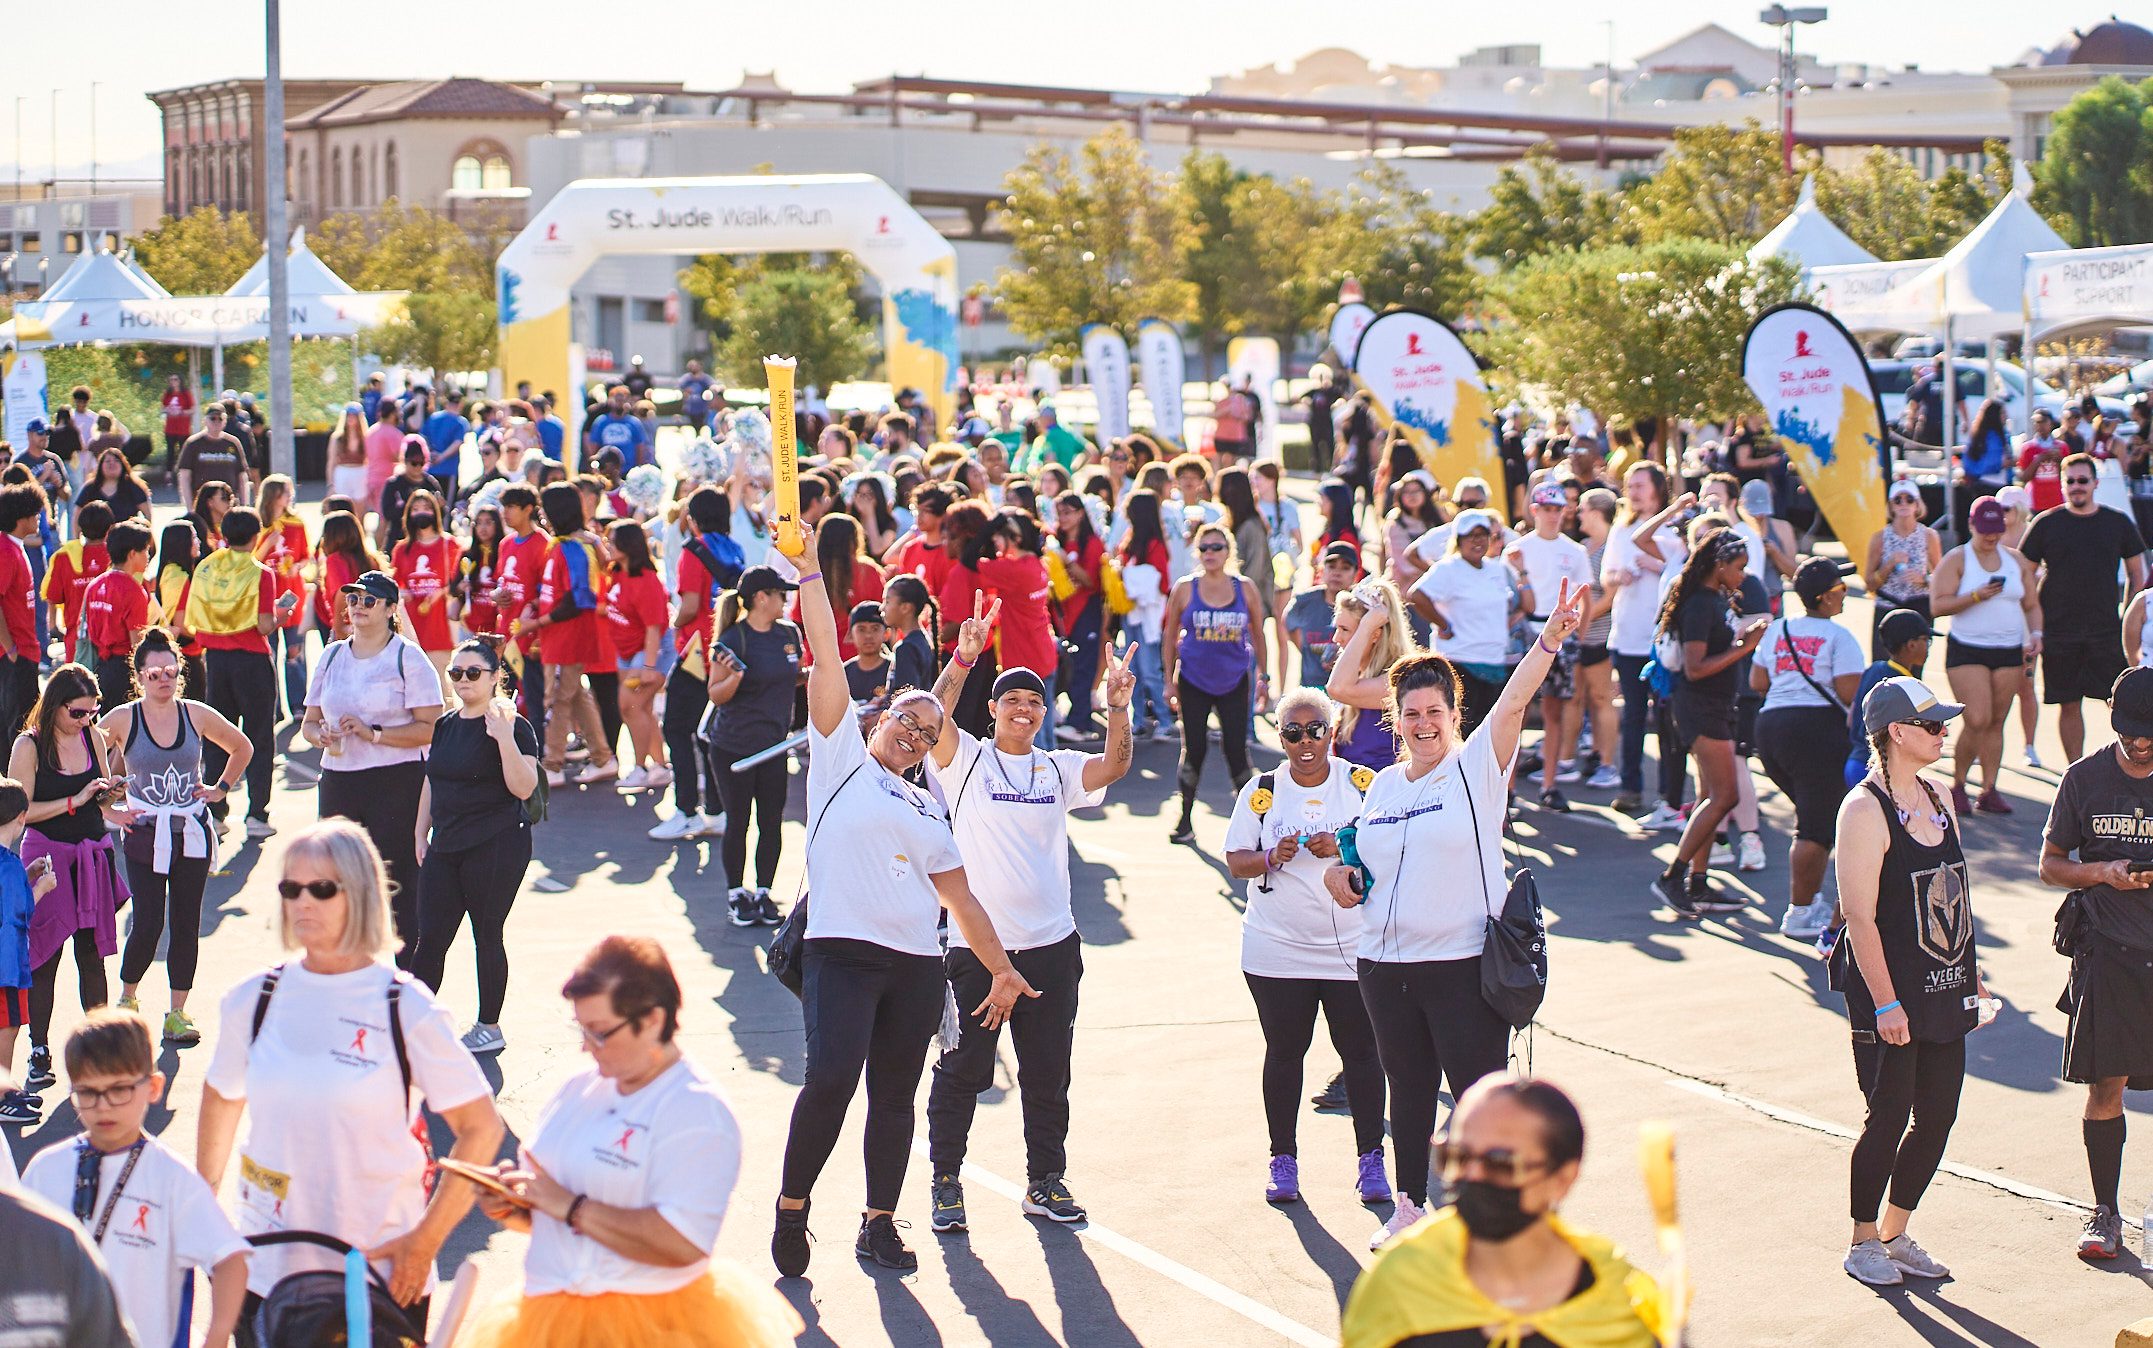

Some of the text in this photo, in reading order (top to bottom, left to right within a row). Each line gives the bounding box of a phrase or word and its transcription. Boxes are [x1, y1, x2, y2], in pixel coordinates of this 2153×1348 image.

[607, 204, 833, 230] St. Jude Walk/Run
[2063, 259, 2146, 282] PARTICIPANT
[2074, 285, 2135, 305] SUPPORT
[120, 309, 203, 328] HONOR
[1780, 367, 1830, 382] St. Jude
[778, 389, 791, 482] ST. JUDE WALK/RUN
[1193, 611, 1211, 628] LOS
[994, 793, 1026, 802] SOBER
[1408, 803, 1442, 818] LIVING
[1277, 826, 1300, 836] RAY
[1304, 825, 1321, 835] OF
[2092, 817, 2136, 836] GOLDEN
[2121, 836, 2153, 844] HOCKEY
